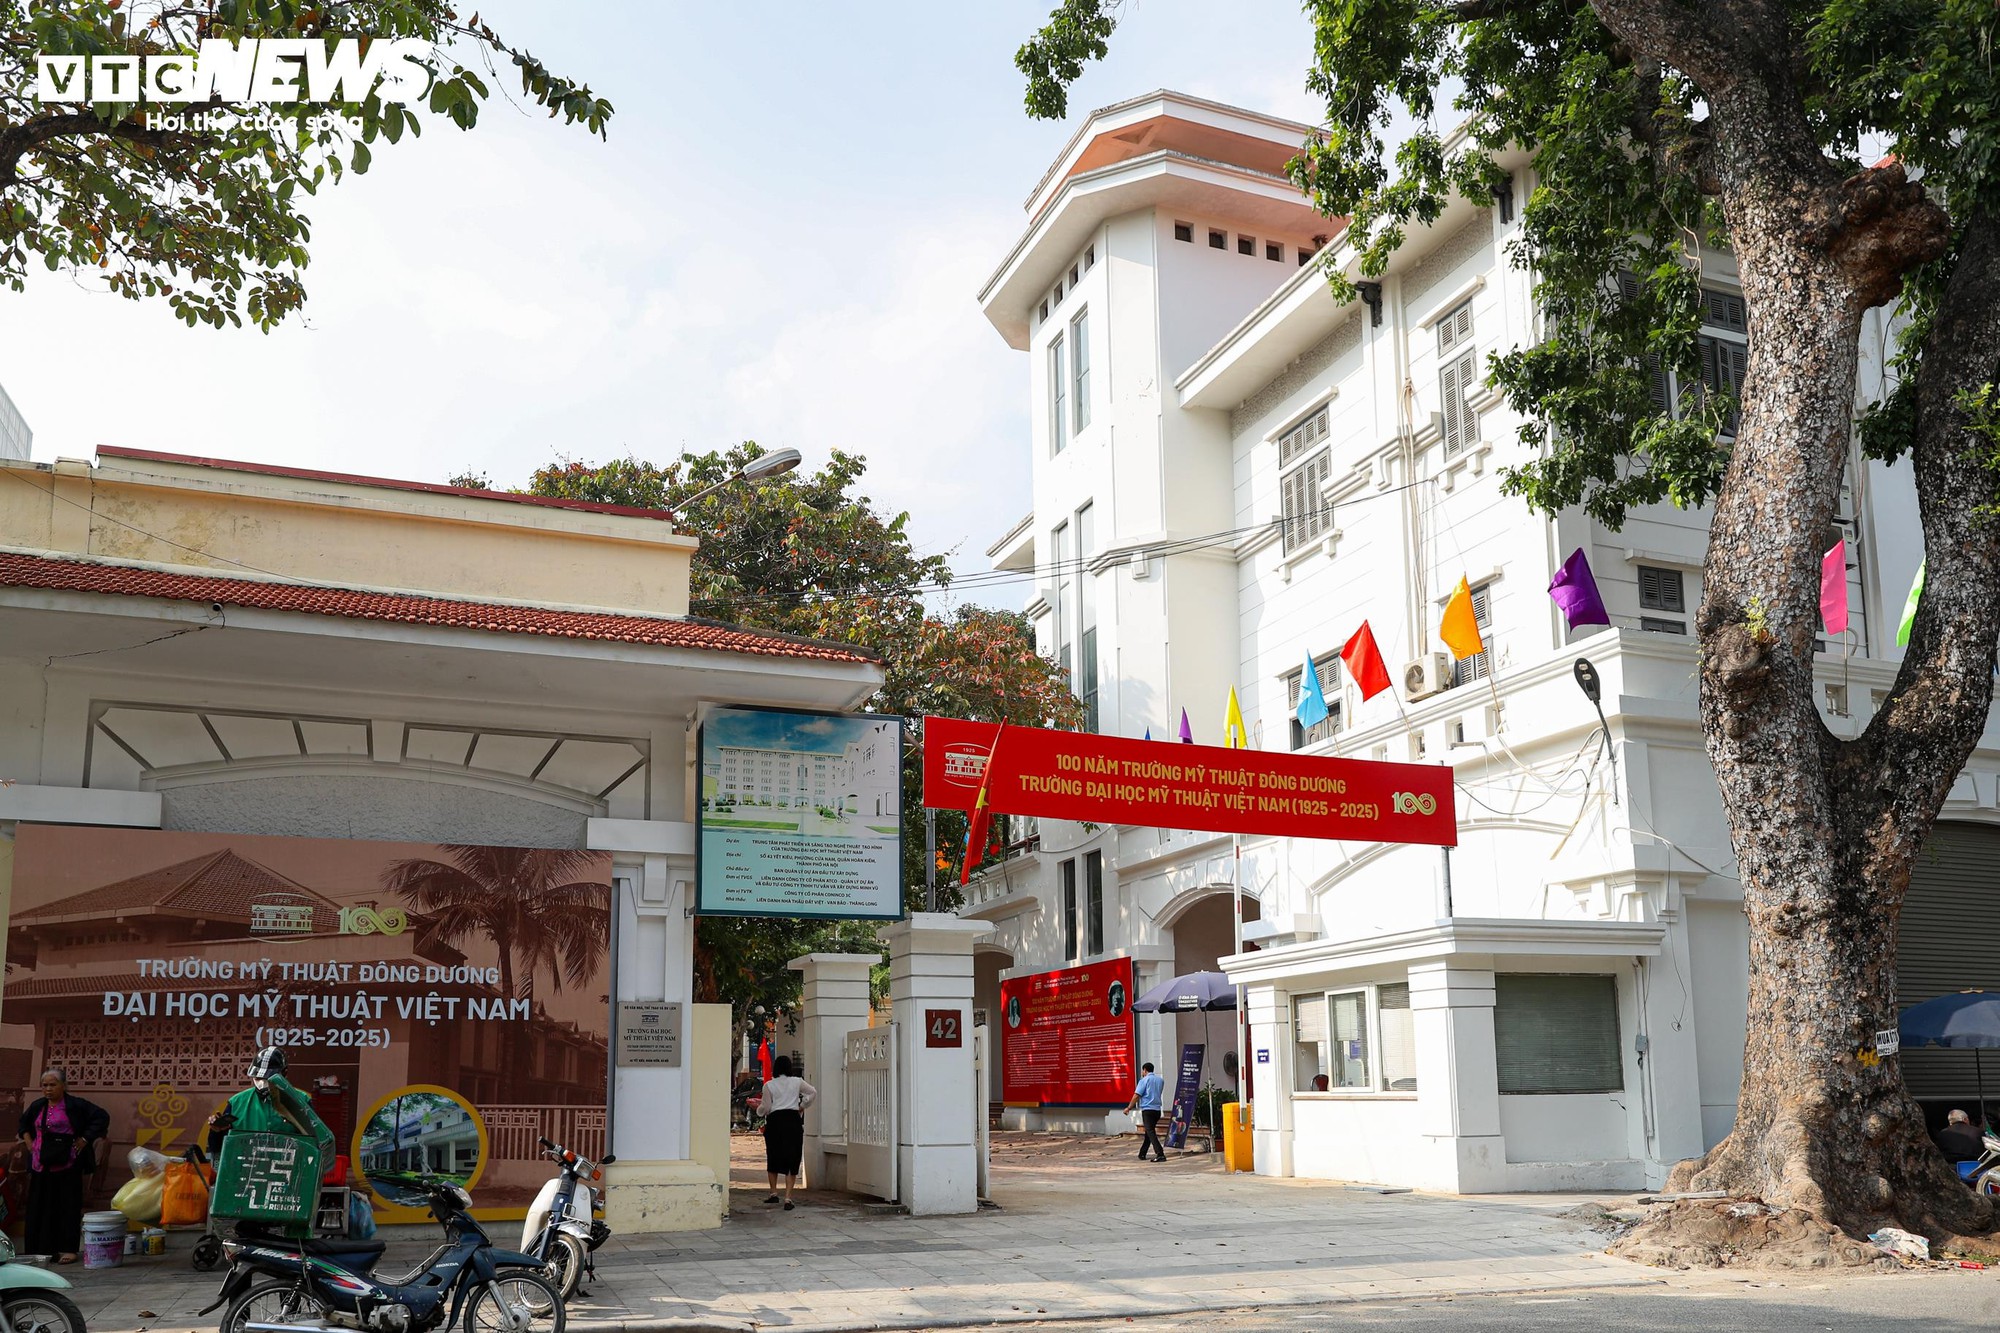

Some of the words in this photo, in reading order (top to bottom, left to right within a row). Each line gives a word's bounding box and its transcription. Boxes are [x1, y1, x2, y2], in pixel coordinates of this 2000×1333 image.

[1056, 754, 1081, 771] 100
[1085, 755, 1119, 775] NĂM
[1122, 760, 1181, 781] TRƯỜNG
[1185, 764, 1205, 783] MỸ
[1209, 768, 1255, 791] THUẬT
[1259, 771, 1297, 790] ĐÔNG
[1300, 776, 1346, 794] DƯƠNG
[1019, 774, 1082, 796] TRƯỜNG
[1086, 781, 1111, 803] ĐẠI
[1115, 784, 1144, 805] HỌC
[1148, 785, 1170, 804] MỸ
[1173, 788, 1220, 811] THUẬT
[1223, 791, 1255, 815] VIỆT
[1258, 797, 1290, 813] NAM
[1293, 799, 1328, 816] (1925
[1340, 803, 1379, 820] 2025)
[136, 956, 233, 979] TRƯỜNG
[240, 958, 273, 979] MỸ
[279, 960, 352, 986] THUẬT
[359, 961, 419, 983] ĐÔNG
[426, 965, 499, 984] DƯƠNG
[103, 992, 157, 1023] ĐẠI
[166, 993, 229, 1024] HỌC
[238, 988, 282, 1018] MỸ
[290, 990, 388, 1025] THUẬT
[396, 991, 460, 1026] VIỆT
[468, 998, 530, 1021] NAM
[255, 1026, 390, 1048] (1925-2025)
[931, 1017, 957, 1039] 42
